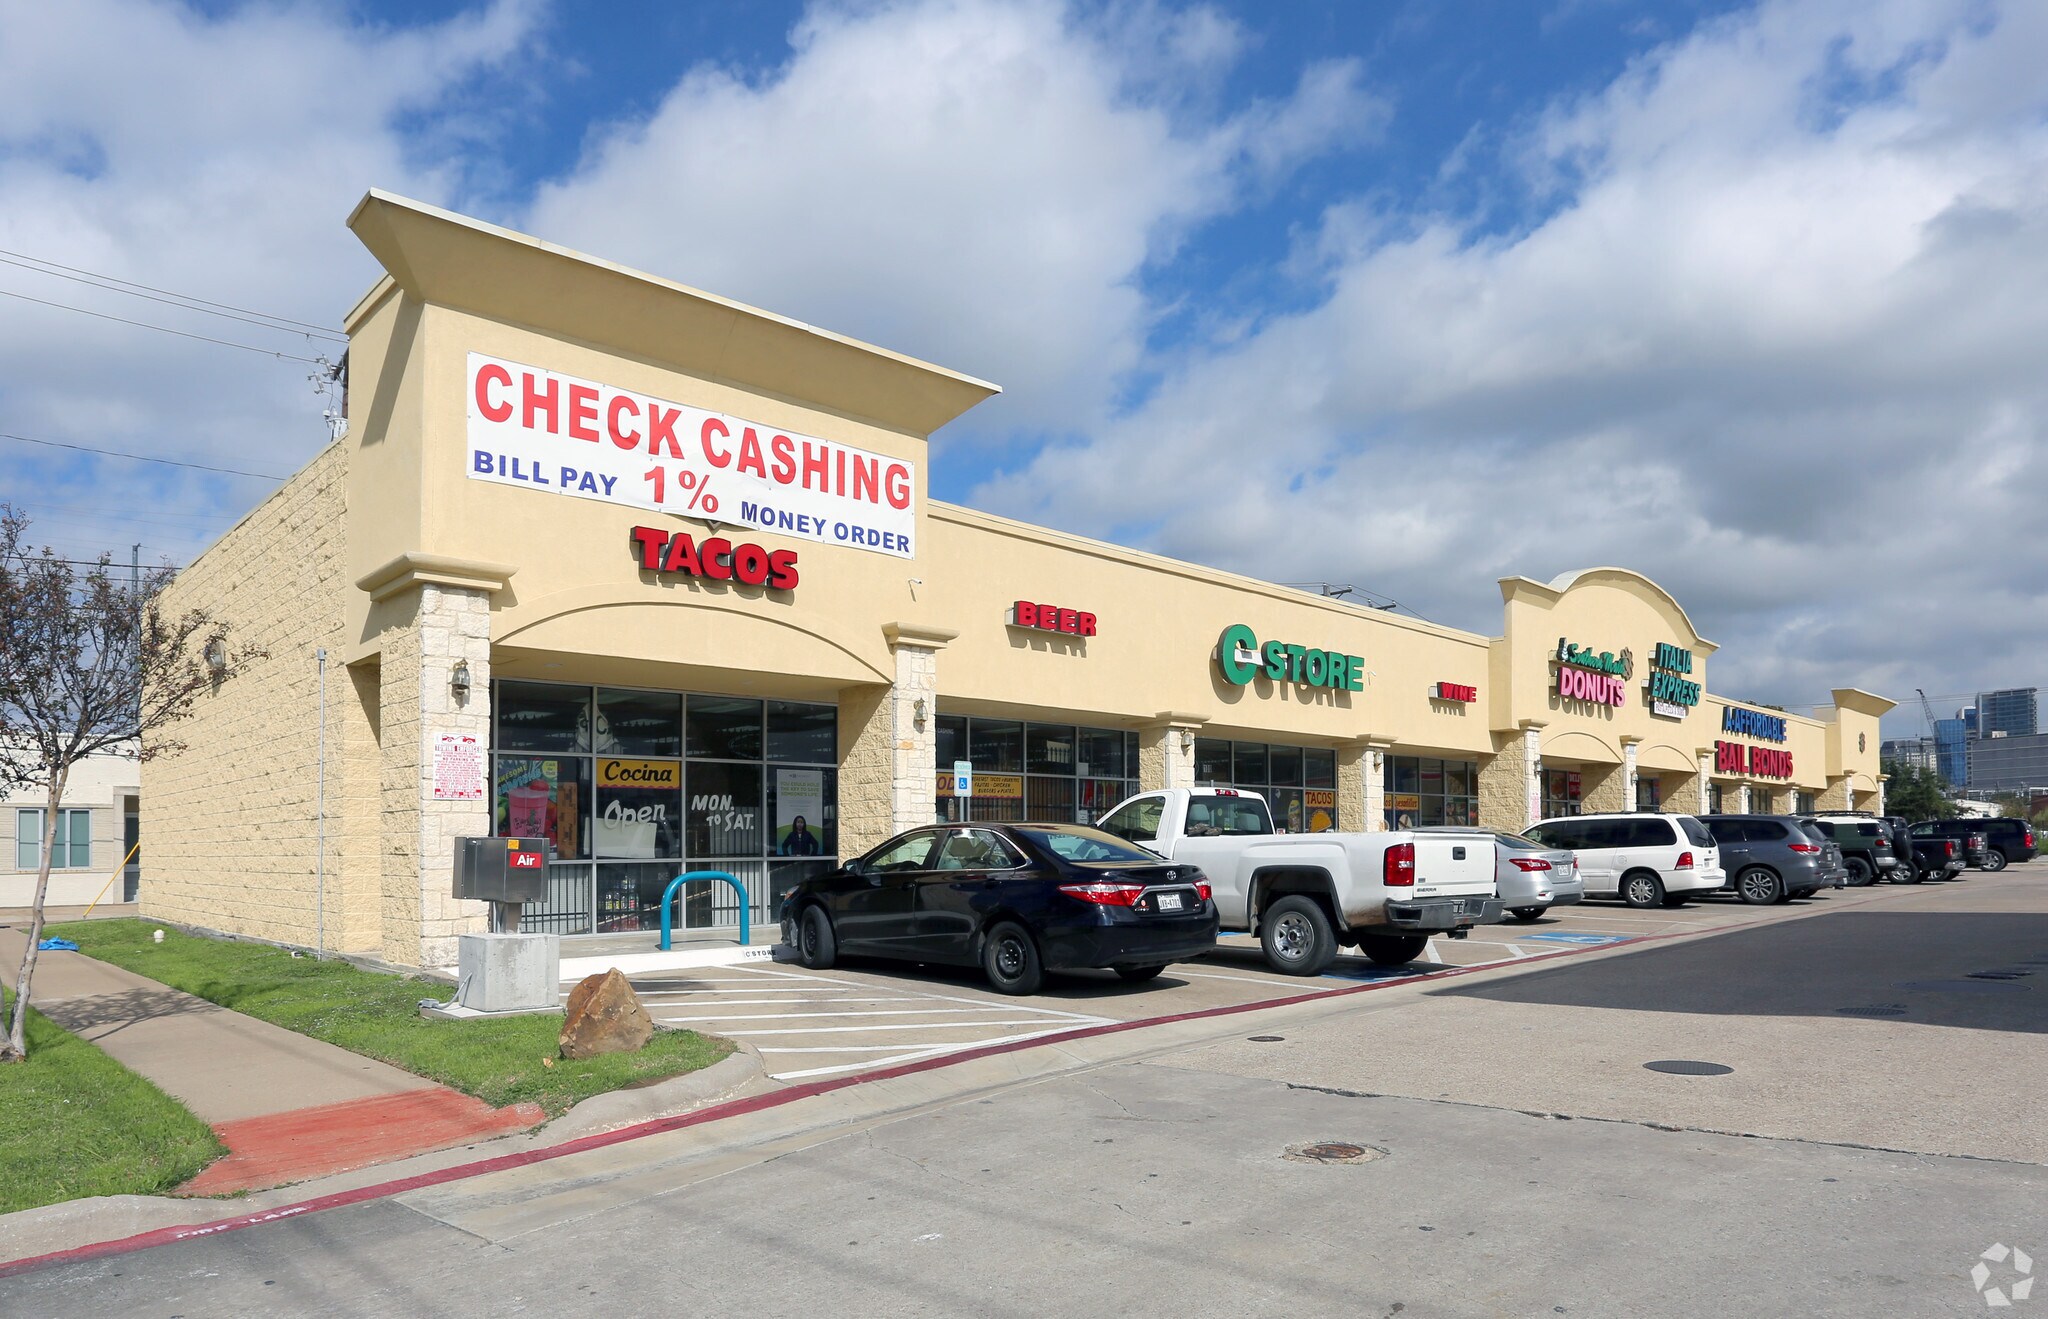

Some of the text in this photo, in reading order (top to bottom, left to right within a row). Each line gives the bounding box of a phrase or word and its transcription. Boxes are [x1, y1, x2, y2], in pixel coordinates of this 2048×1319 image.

[474, 363, 910, 510] CHECK CASHING
[474, 450, 618, 496] BILL PAY
[643, 465, 719, 514] 1%
[741, 501, 910, 553] MONEY ORDER
[632, 526, 799, 591] TACOS
[1014, 600, 1097, 637] BEER
[1217, 624, 1365, 692] C STORE
[1656, 642, 1693, 674] ITALIA
[1437, 681, 1477, 703] WINE
[1558, 667, 1625, 707] DONUTS
[1651, 672, 1701, 706] EXPRESS
[604, 761, 672, 782] Cocina
[1715, 740, 1793, 777] BAIL BONDS
[604, 800, 666, 831] Open
[691, 795, 735, 811] MON.
[1305, 792, 1332, 805] TACOS
[706, 811, 754, 832] TO SAT.
[517, 854, 535, 866] Air
